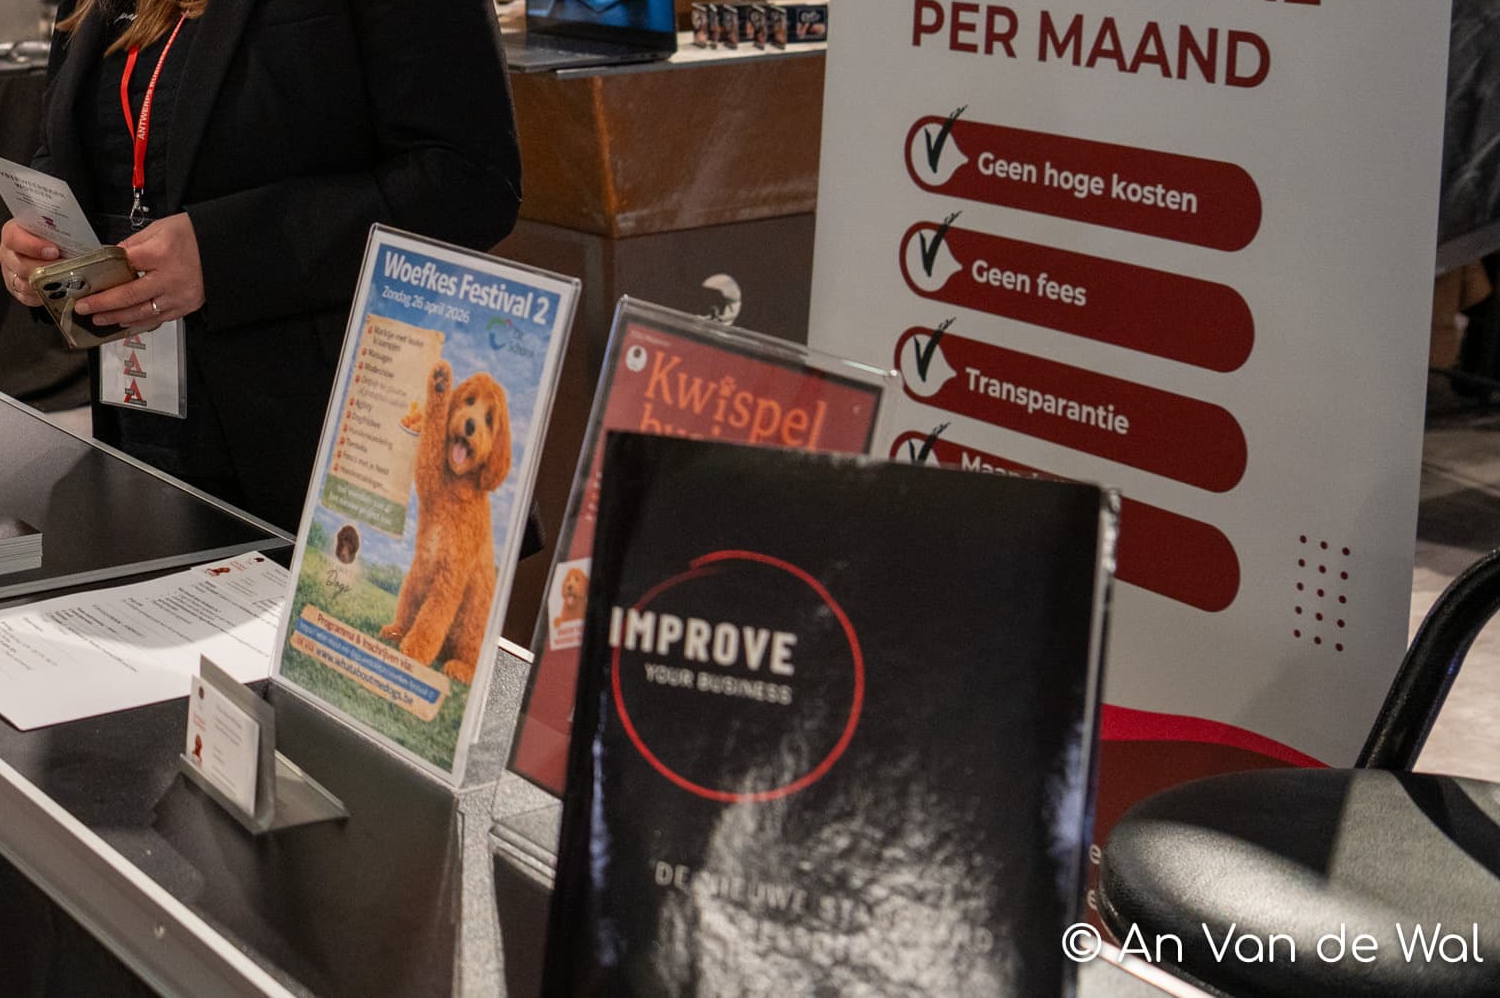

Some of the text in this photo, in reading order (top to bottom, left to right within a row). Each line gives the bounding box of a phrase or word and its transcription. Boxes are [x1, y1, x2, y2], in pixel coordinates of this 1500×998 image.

[1038, 10, 1271, 88] MAAND
[978, 152, 1198, 214] Geen hoge kosten
[382, 286, 411, 308] Zondag
[424, 299, 444, 316] april
[444, 303, 471, 324] 2026
[383, 251, 550, 325] Woefkes Festival 2
[972, 259, 1087, 306] Geen fees
[643, 350, 827, 449] Kwispel
[965, 367, 1130, 435] Transparantie
[317, 612, 355, 642] Programma
[362, 635, 400, 665] Inschrijven
[608, 606, 797, 676] IMPROVE
[644, 662, 793, 705] YOUR BUSINESS
[655, 860, 690, 889] DE
